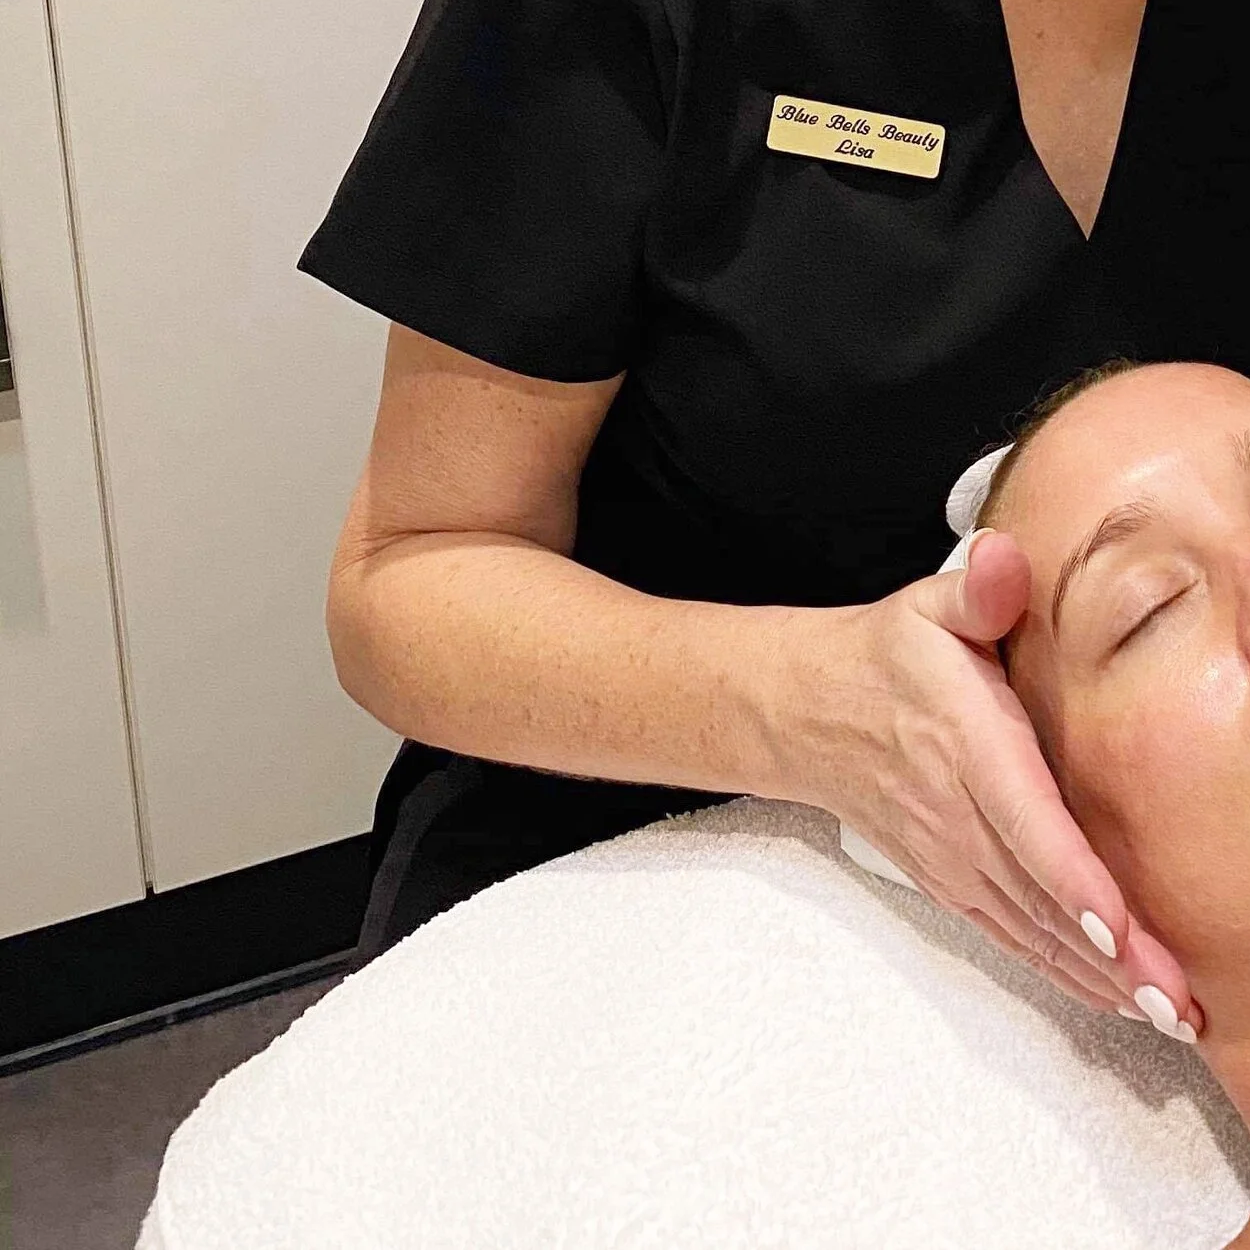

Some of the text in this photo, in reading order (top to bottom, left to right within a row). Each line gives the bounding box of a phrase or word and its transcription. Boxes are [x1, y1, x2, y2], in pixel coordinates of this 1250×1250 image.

[776, 104, 940, 152] Blue Bells Beauty
[834, 139, 875, 159] Lisa
